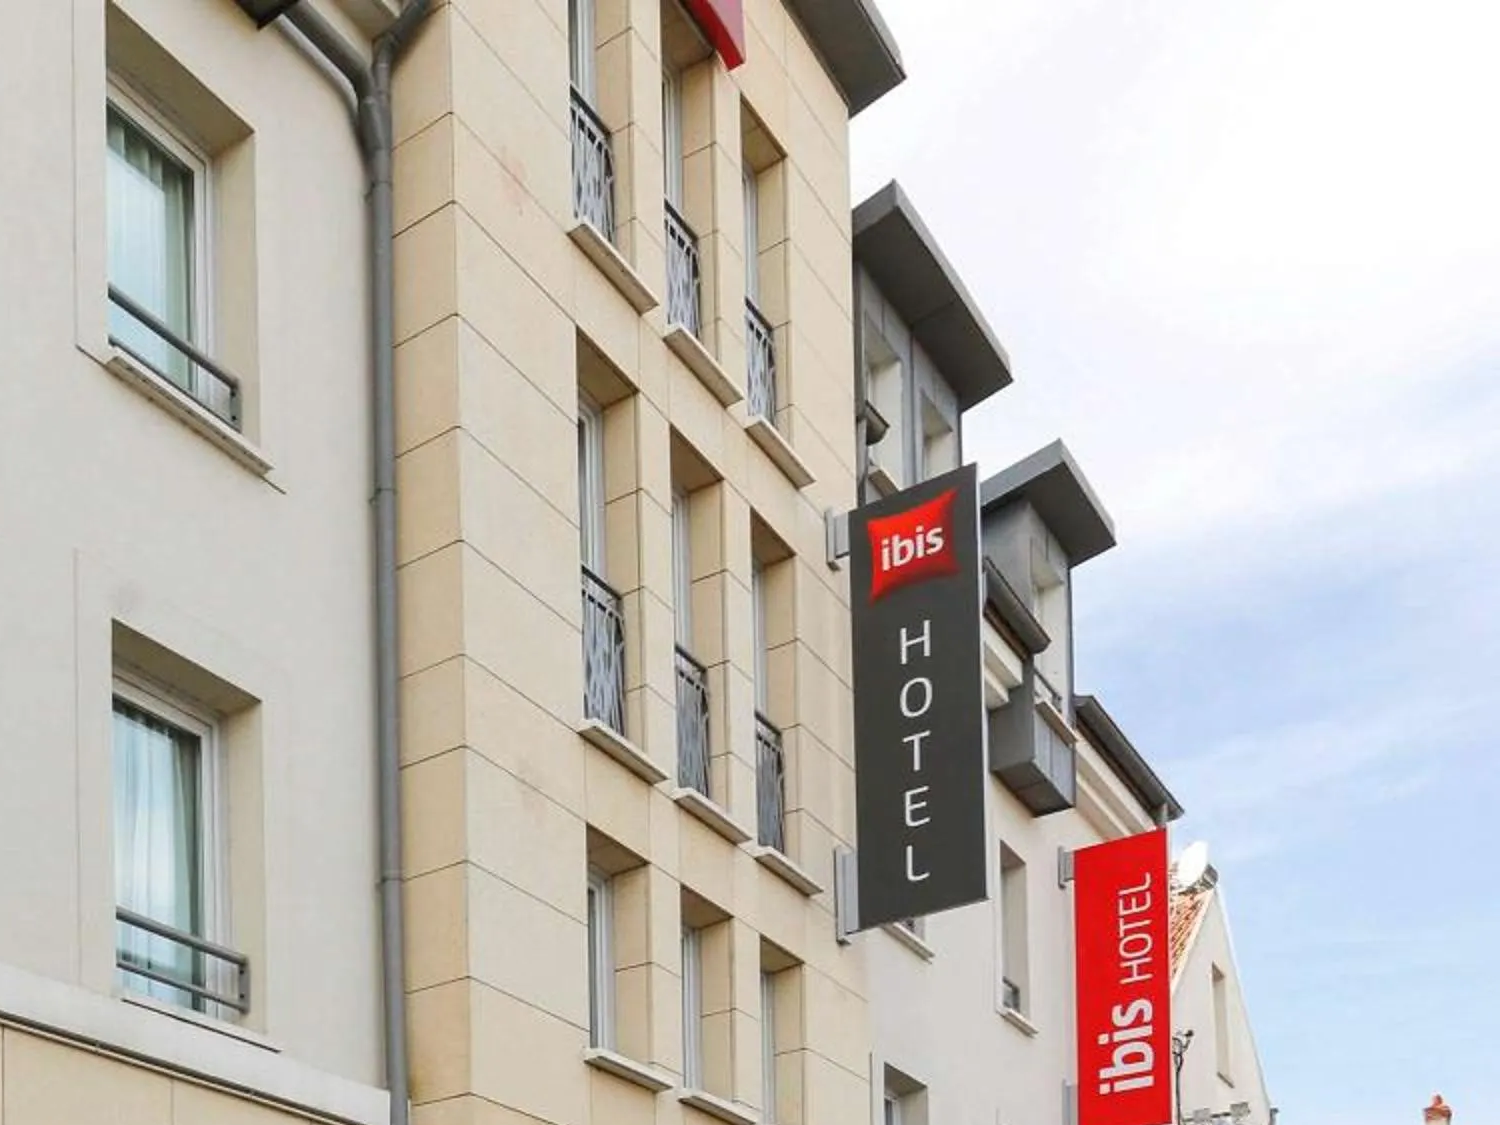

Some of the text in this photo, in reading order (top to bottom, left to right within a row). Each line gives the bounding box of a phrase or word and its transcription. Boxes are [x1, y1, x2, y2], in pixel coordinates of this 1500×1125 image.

[881, 525, 944, 572] ibis
[900, 619, 933, 881] HOTEL
[1098, 872, 1155, 1095] ibis HOTEL
